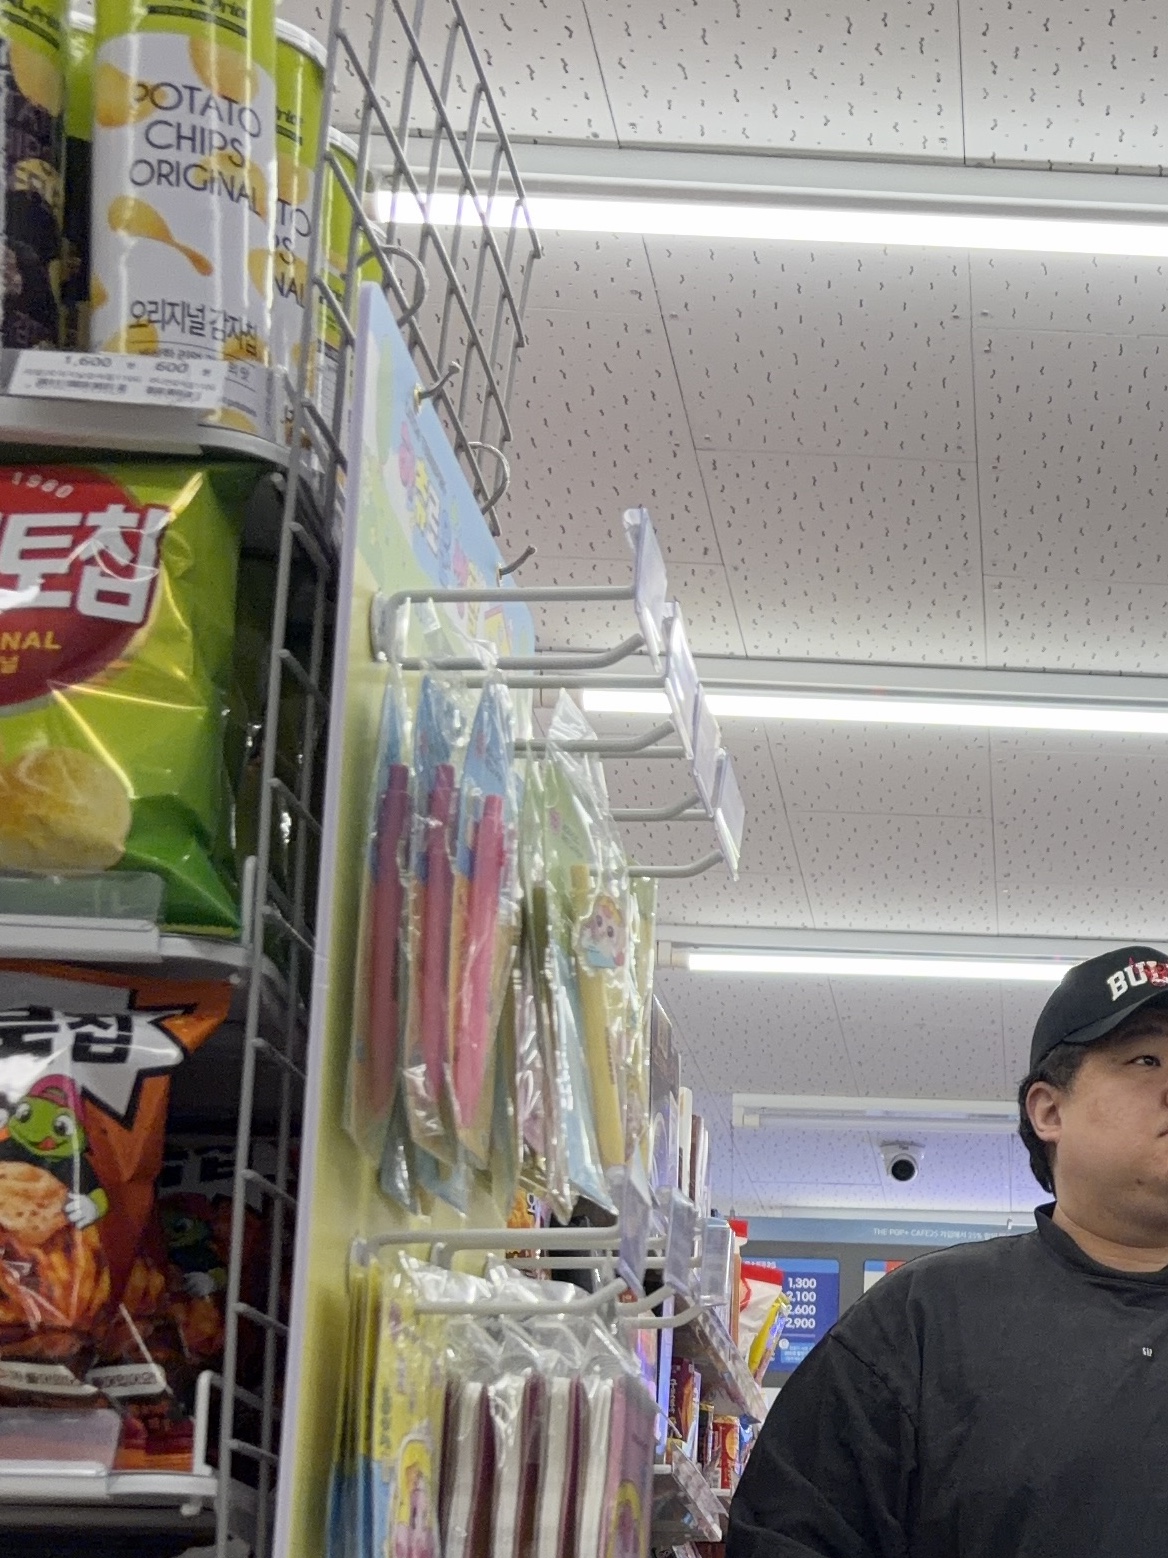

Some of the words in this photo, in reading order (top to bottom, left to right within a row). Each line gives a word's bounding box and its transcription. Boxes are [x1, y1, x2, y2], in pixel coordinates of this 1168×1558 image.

[144, 119, 246, 169] CHIPS
[129, 158, 262, 218] ORIGINAL
[277, 198, 312, 238] TO
[129, 298, 207, 338] 오리지널
[0, 503, 169, 625] 토칩
[787, 1277, 817, 1290] 1,300
[785, 1317, 816, 1330] 2,900
[786, 1304, 816, 1316] 2,600
